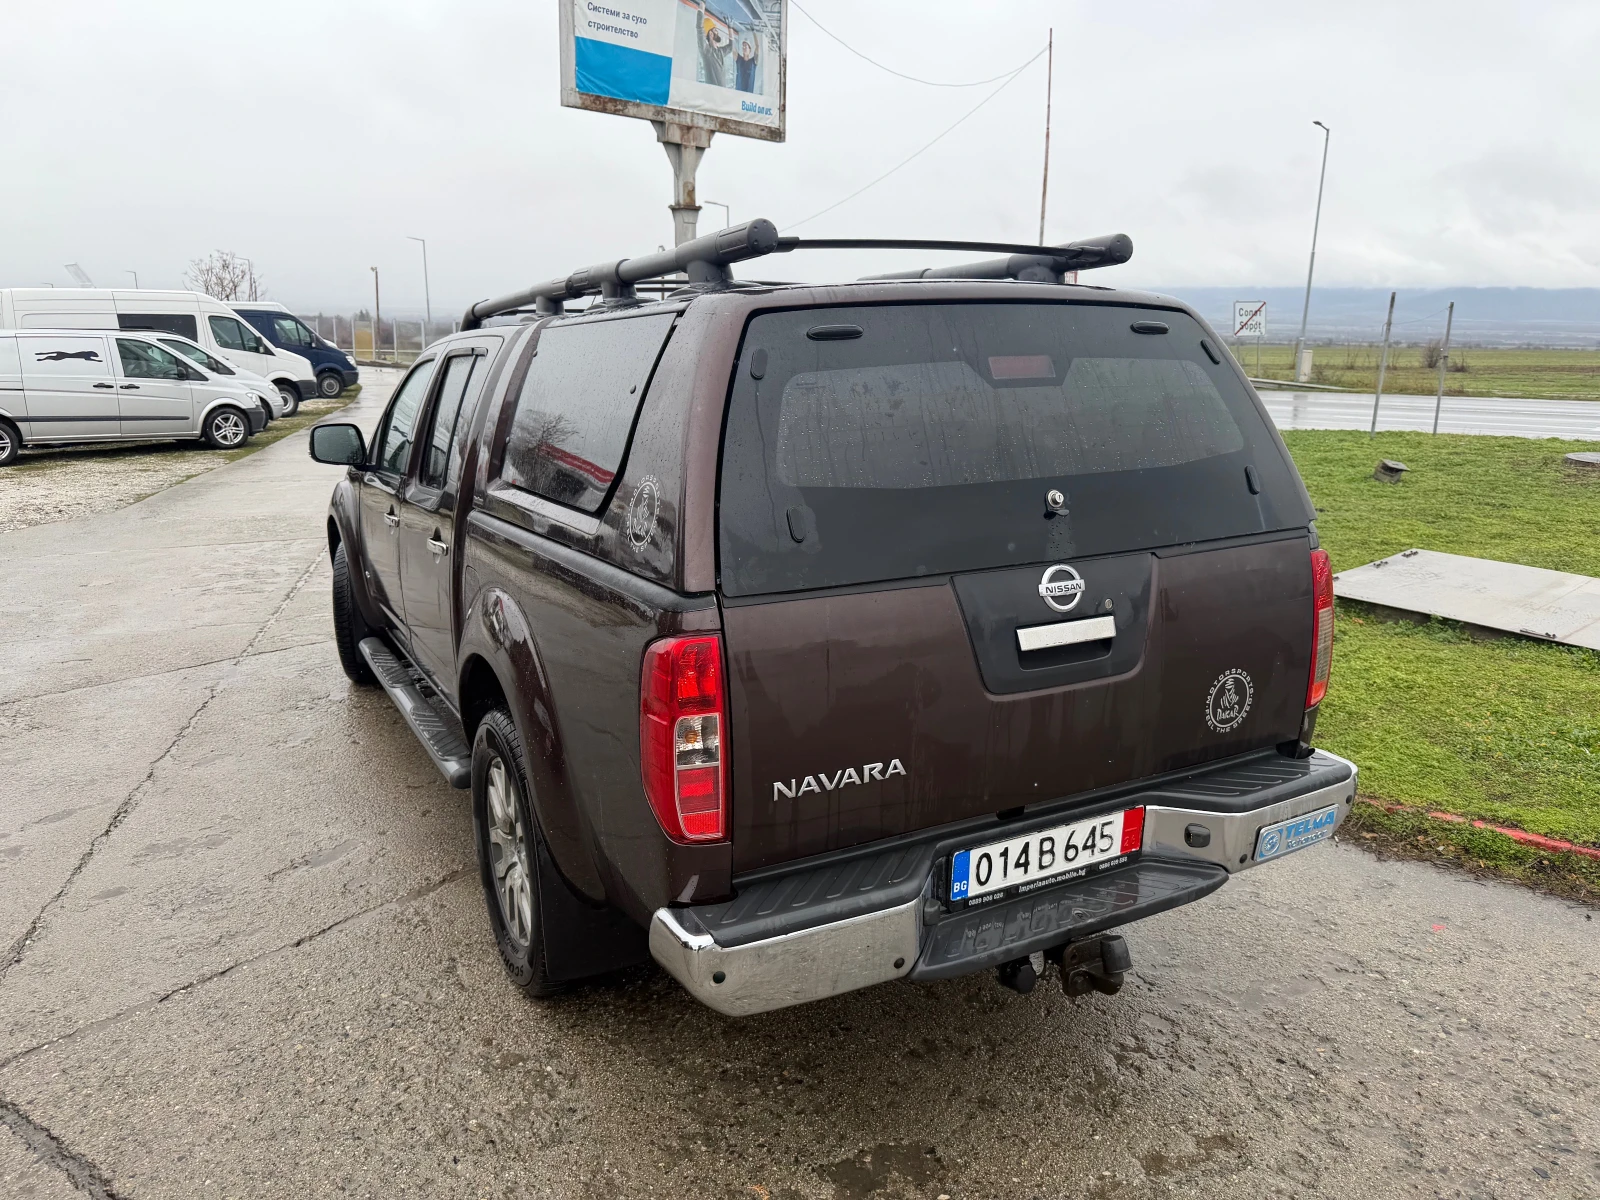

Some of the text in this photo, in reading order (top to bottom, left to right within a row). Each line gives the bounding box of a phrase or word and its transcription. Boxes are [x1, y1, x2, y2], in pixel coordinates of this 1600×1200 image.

[587, 1, 648, 25] Системи за сухо
[587, 19, 639, 39] строителство
[741, 100, 757, 113] Build
[757, 105, 765, 115] on
[1045, 582, 1082, 594] NISSAN
[1205, 668, 1254, 704] MOTORSPORTS
[1216, 704, 1239, 722] DAKAR
[772, 758, 907, 802] NAVARA
[1285, 810, 1335, 840] TELMA
[953, 880, 968, 893] BG
